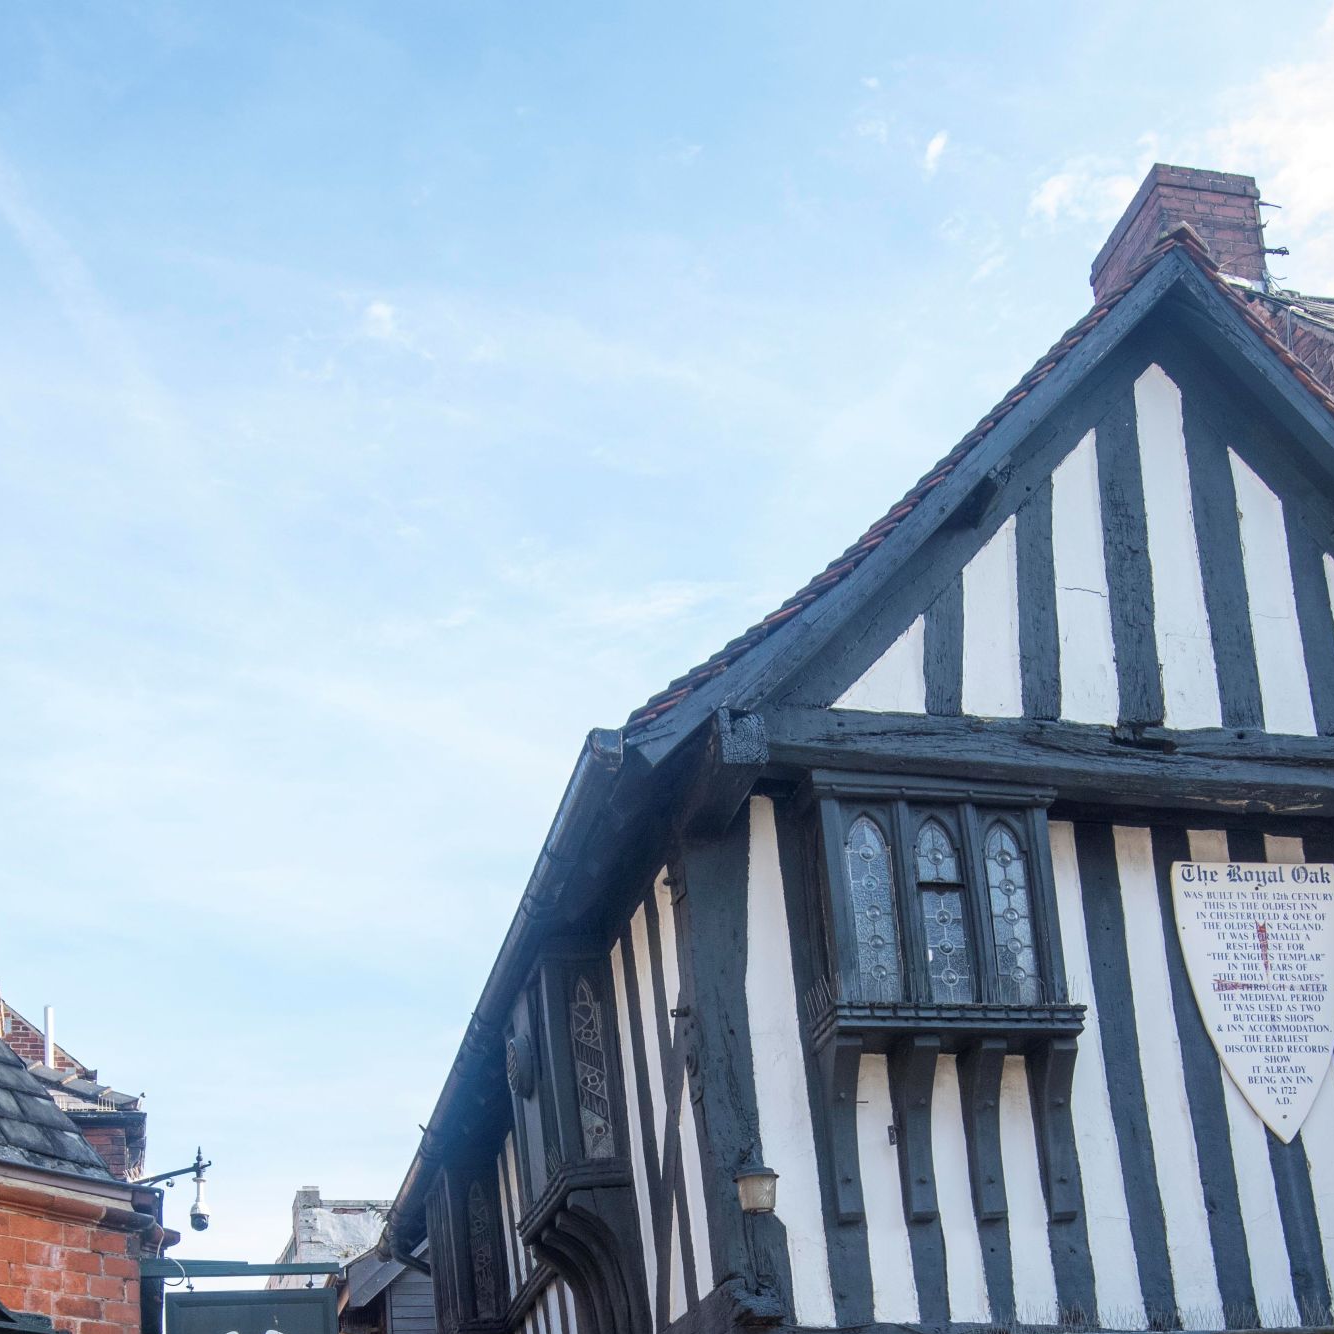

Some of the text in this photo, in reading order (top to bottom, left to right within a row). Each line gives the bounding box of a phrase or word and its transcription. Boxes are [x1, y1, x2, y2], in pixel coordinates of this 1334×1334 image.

[1181, 864, 1331, 887] The Royal Oak
[1183, 891, 1334, 900] WAS BUILT IN THE 12th CENTURY
[1203, 902, 1317, 910] THIS IS THE OLDEST INN
[1196, 912, 1327, 920] IN CHESTERFIELD & ONE OF
[1224, 922, 1258, 930] OLDEST
[1278, 922, 1324, 931] ENGLAND.
[1217, 932, 1310, 940] IT WAS FORMALLY A
[1226, 942, 1304, 951] REST-HOUSE FOR
[1234, 952, 1274, 961] KNIGHTS
[1228, 962, 1238, 970] IN
[1241, 962, 1260, 970] THE
[1296, 962, 1308, 971] OF
[1240, 973, 1264, 981] HOLY
[1241, 984, 1286, 992] THROUGH
[1299, 984, 1328, 992] AFTER
[1218, 993, 1236, 1001] THE
[1223, 1004, 1232, 1012] IT
[1248, 1024, 1332, 1032] ACCOMMODATION.
[1242, 1034, 1262, 1042] THE
[1287, 1045, 1330, 1053] RECORDS
[1264, 1055, 1292, 1063] SHOW
[1264, 1066, 1306, 1074] ALREADY
[1248, 1076, 1313, 1084] BEING AN INN
[1267, 1086, 1297, 1094] IN 1722
[1275, 1097, 1292, 1105] A.D.
